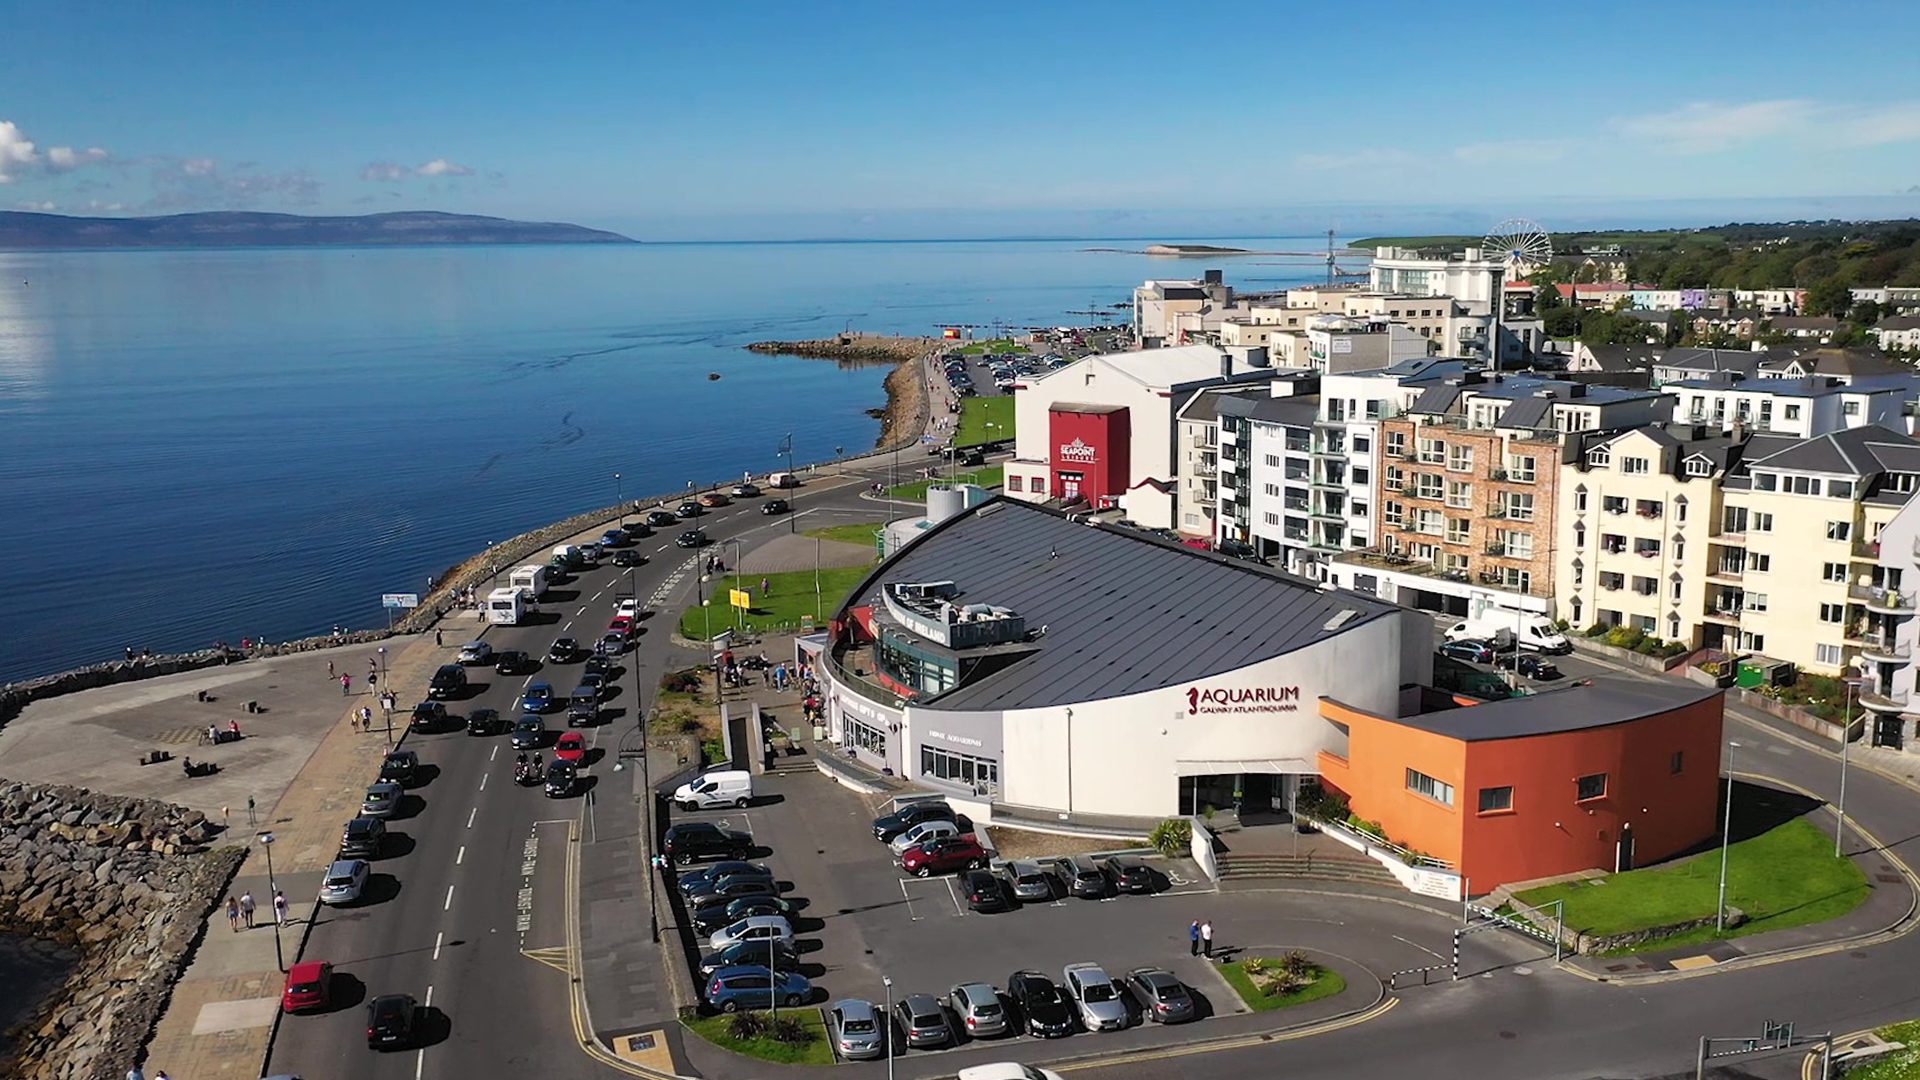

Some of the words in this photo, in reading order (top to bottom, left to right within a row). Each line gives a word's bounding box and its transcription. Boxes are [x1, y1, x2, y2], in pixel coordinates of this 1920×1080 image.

[1061, 446, 1095, 456] SEAPOINT
[915, 621, 946, 644] IRELAND
[1200, 686, 1299, 705] AQUARIUM
[1200, 706, 1232, 714] GALWAY
